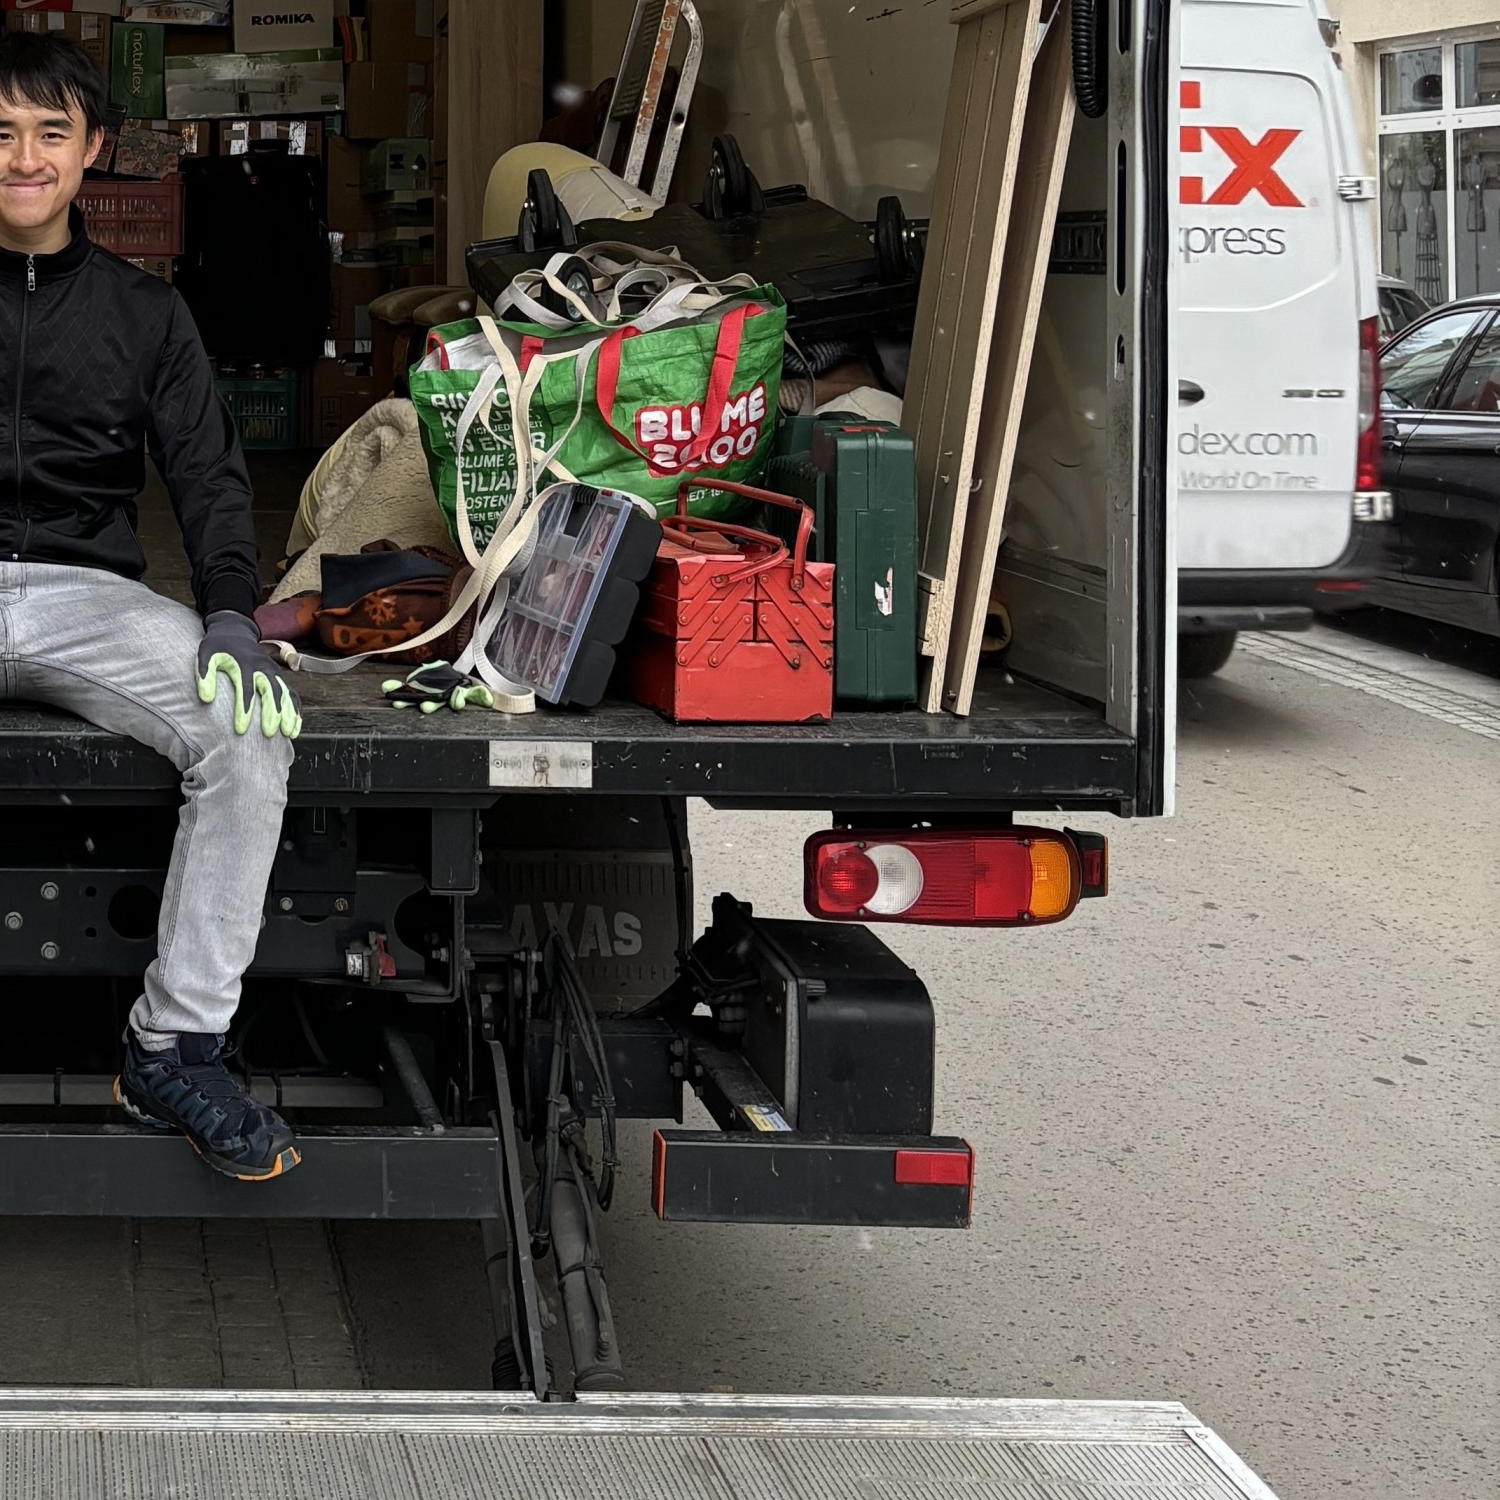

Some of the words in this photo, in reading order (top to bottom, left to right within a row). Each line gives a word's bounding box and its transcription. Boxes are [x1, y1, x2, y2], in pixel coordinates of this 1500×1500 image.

[251, 12, 315, 27] ROMIKA
[132, 32, 144, 94] natuflex
[478, 431, 546, 451] EINR
[1177, 423, 1318, 456] dex.com
[455, 453, 505, 469] BLUME
[461, 469, 518, 492] FILIA
[686, 488, 708, 502] EIT
[510, 902, 643, 959] AXAS
